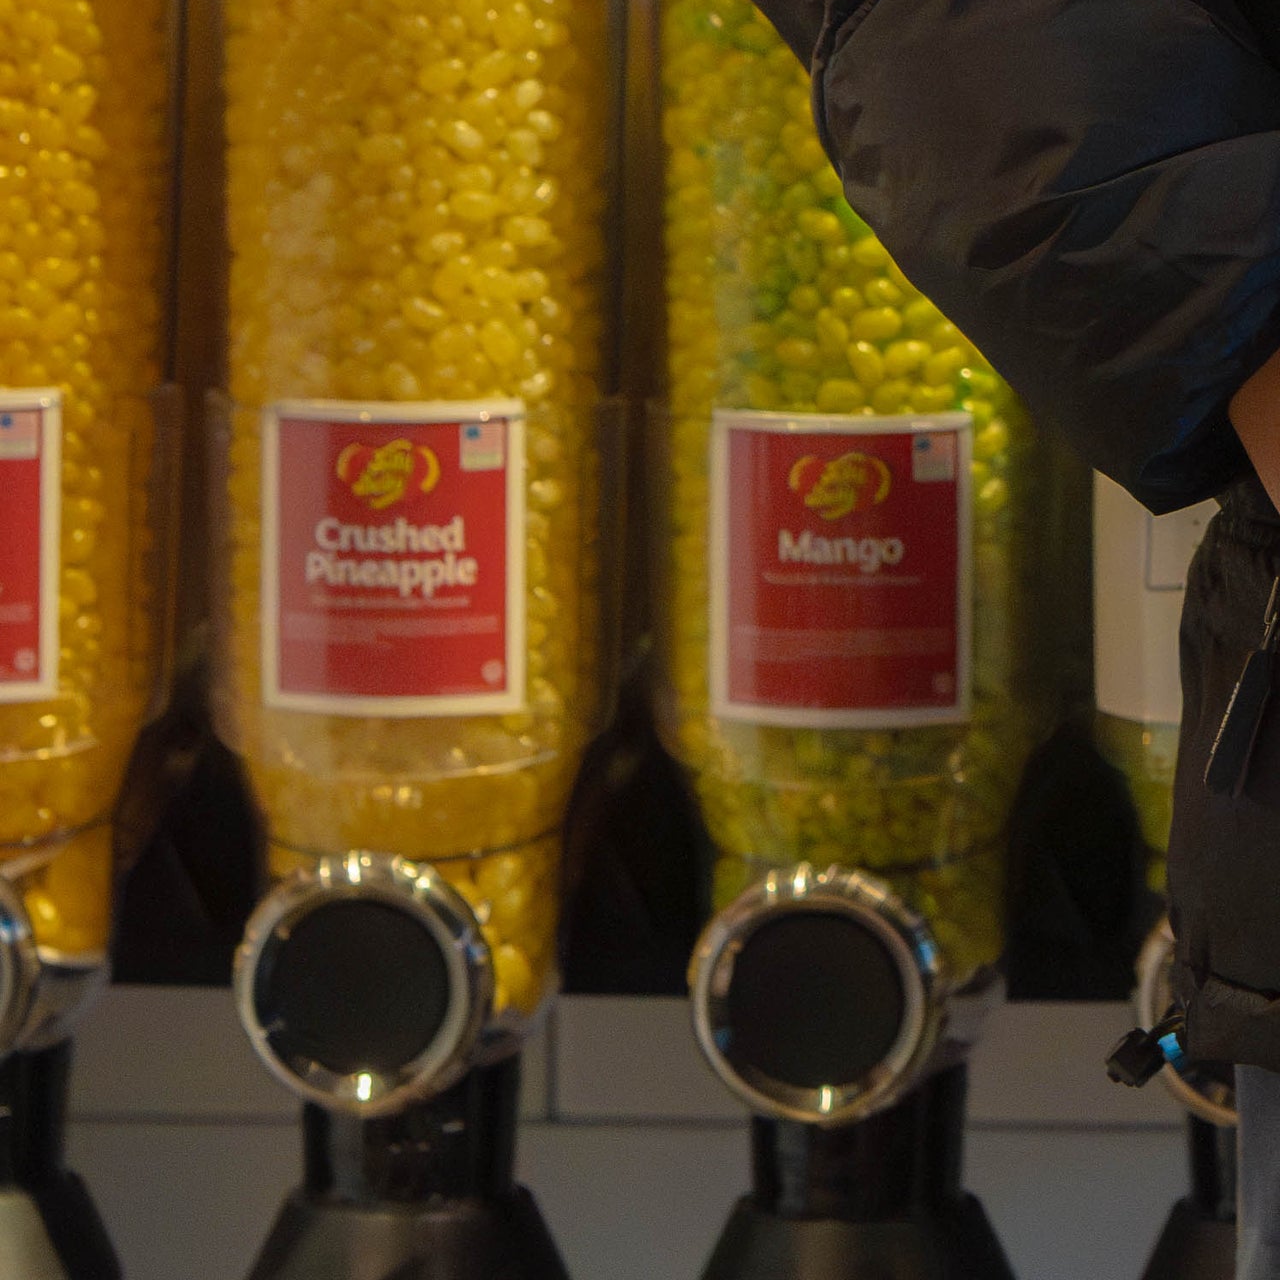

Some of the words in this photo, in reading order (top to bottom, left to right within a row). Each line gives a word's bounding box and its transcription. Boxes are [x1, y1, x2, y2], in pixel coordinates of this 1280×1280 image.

[314, 516, 465, 553] Crushed
[778, 529, 905, 573] Mango
[305, 552, 479, 598] Pineapple
